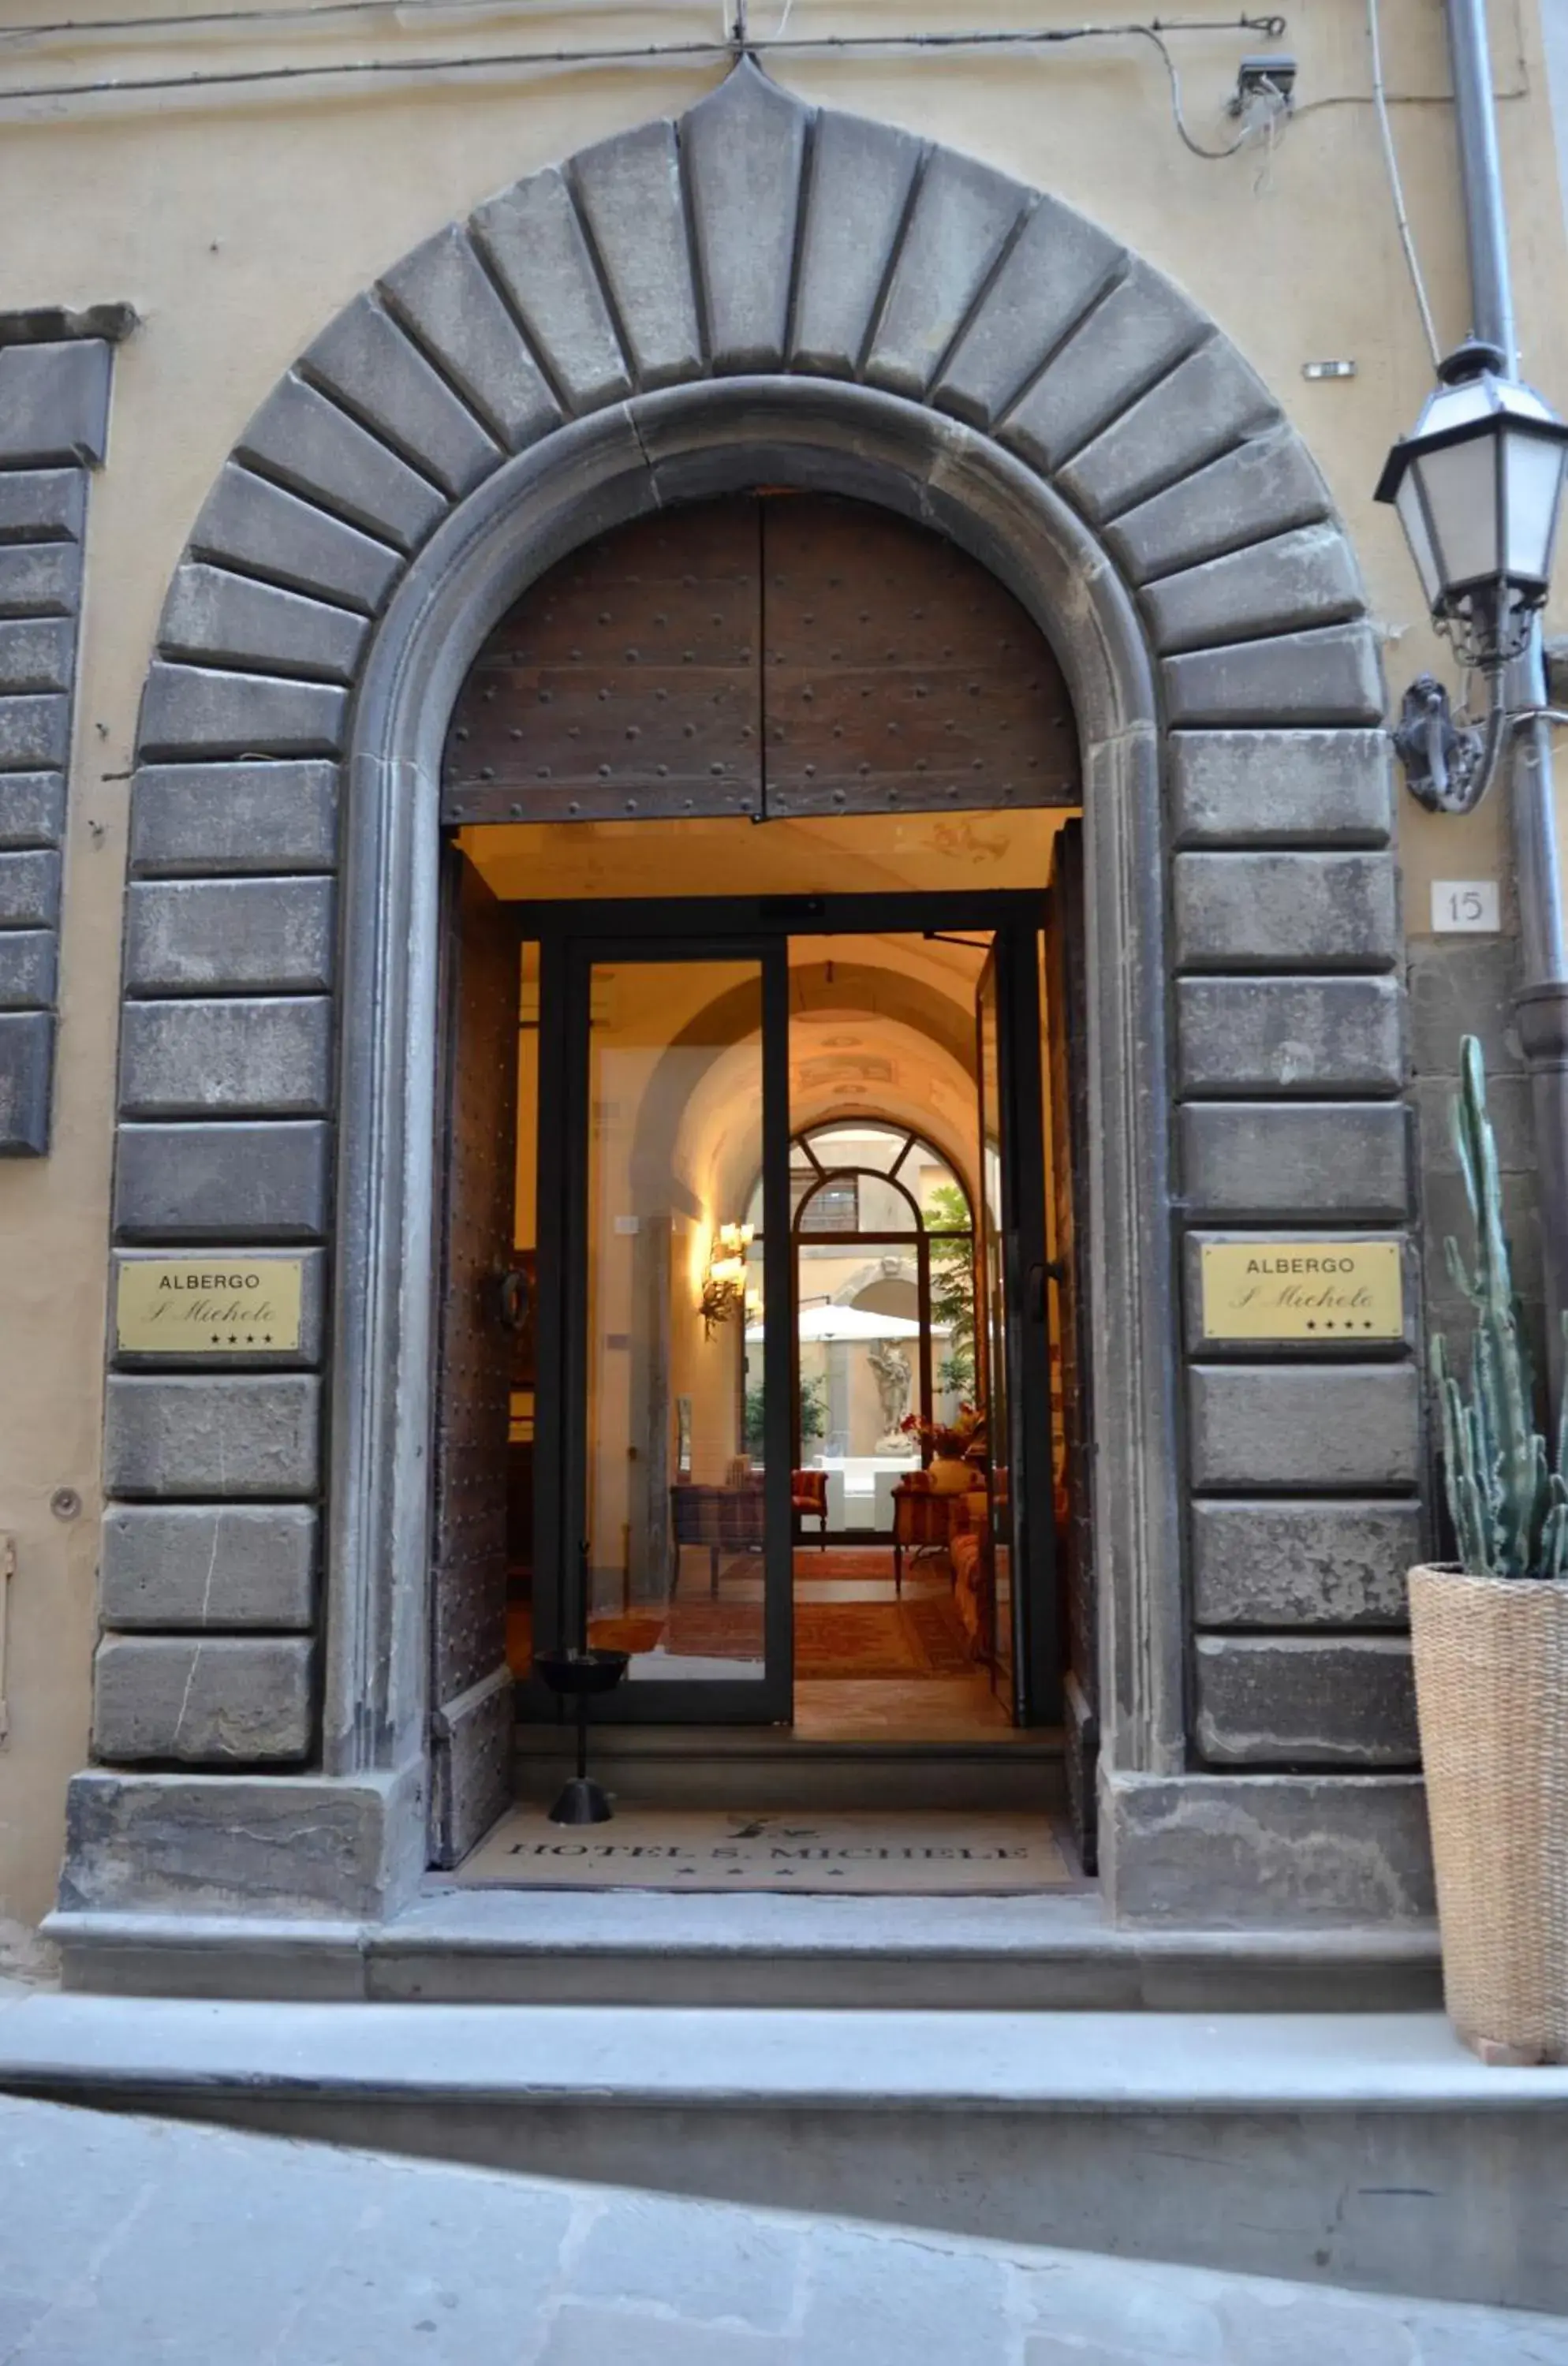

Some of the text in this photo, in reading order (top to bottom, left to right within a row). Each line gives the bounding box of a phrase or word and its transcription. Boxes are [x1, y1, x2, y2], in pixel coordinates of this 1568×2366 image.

[1448, 890, 1484, 922] 15
[1246, 1258, 1355, 1274] ALBERGO
[159, 1274, 259, 1289] ALBERGO
[1273, 1285, 1373, 1309] Michele
[181, 1299, 274, 1323] Michele
[508, 1844, 696, 1858] HOTEL
[768, 1847, 1029, 1860] MICHELE
